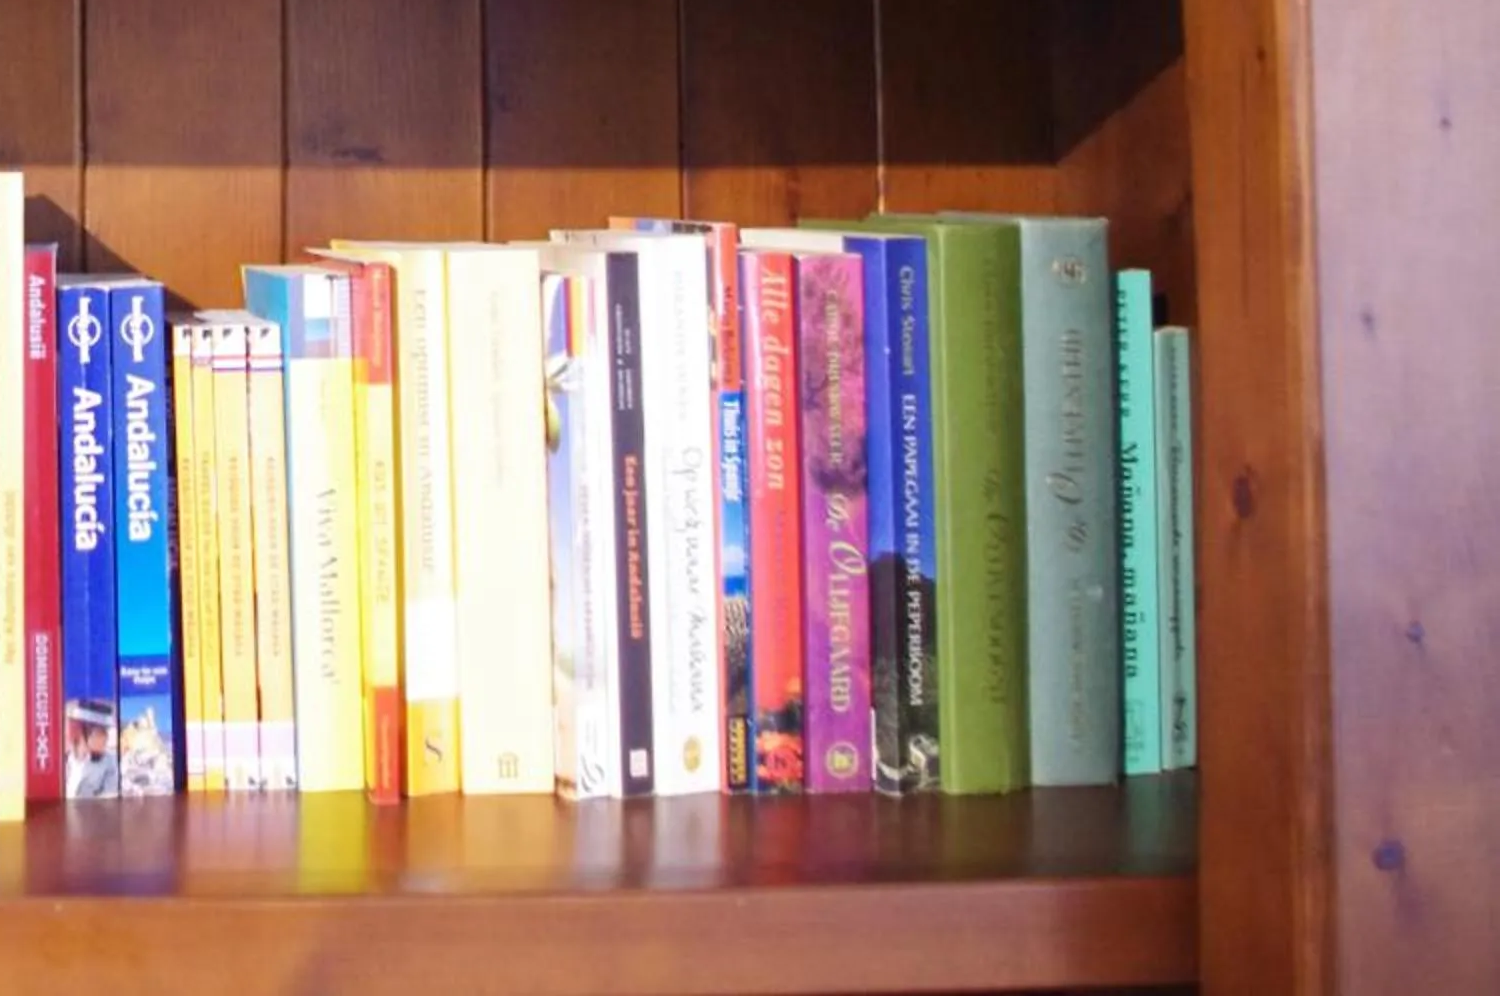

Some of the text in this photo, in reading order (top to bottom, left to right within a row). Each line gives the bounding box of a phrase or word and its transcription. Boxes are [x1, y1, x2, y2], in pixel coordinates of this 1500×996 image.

[899, 265, 916, 311] Chris
[760, 266, 790, 490] Alle dagen zon
[901, 393, 917, 431] EEN
[73, 386, 106, 551] Andalucía
[126, 374, 159, 542] Andalucía
[903, 435, 920, 527] PAPEGAAI
[905, 532, 920, 554] IN
[906, 558, 921, 586] DE
[907, 590, 924, 706] PEPERBOOM
[1123, 567, 1145, 679] mañana
